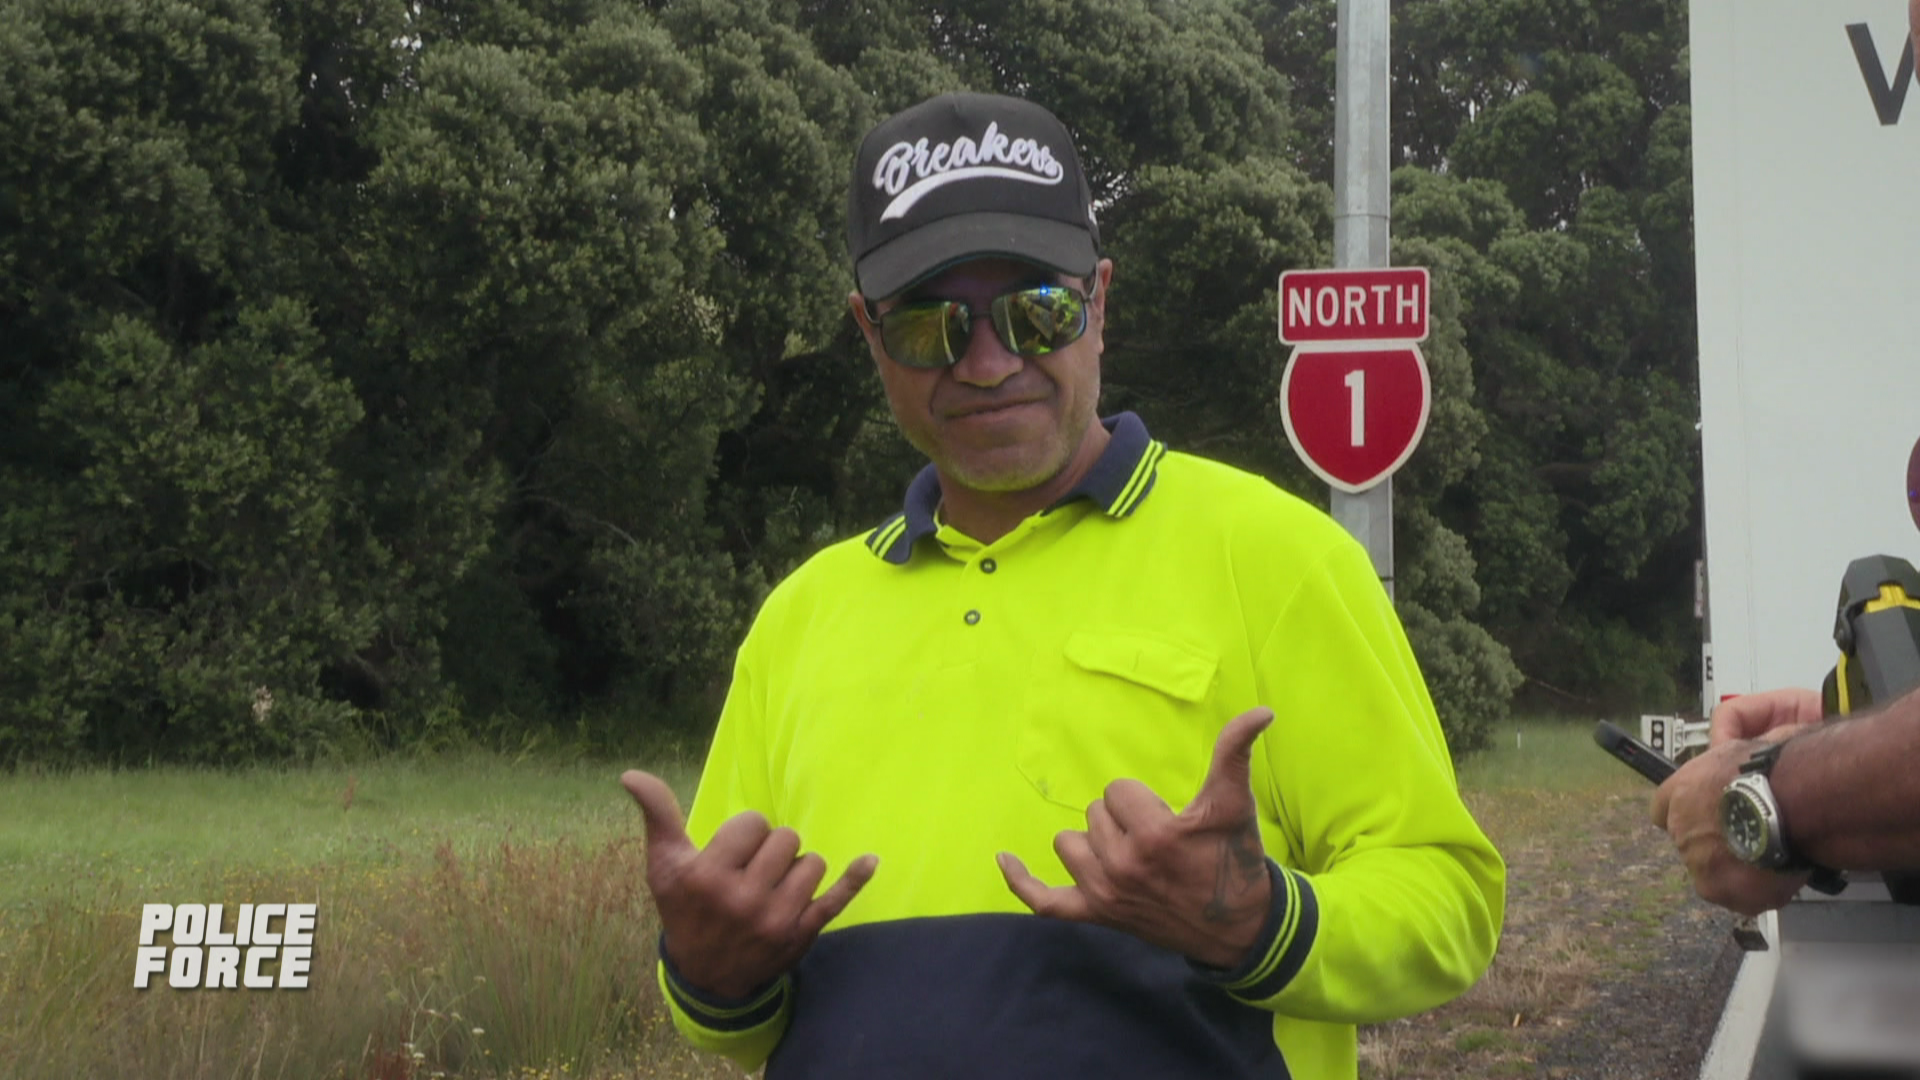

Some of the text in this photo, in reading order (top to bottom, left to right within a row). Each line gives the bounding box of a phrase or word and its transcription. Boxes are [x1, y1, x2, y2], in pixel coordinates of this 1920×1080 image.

[872, 120, 1057, 196] Breakers
[1289, 284, 1419, 327] NORTH
[1345, 369, 1365, 447] 1
